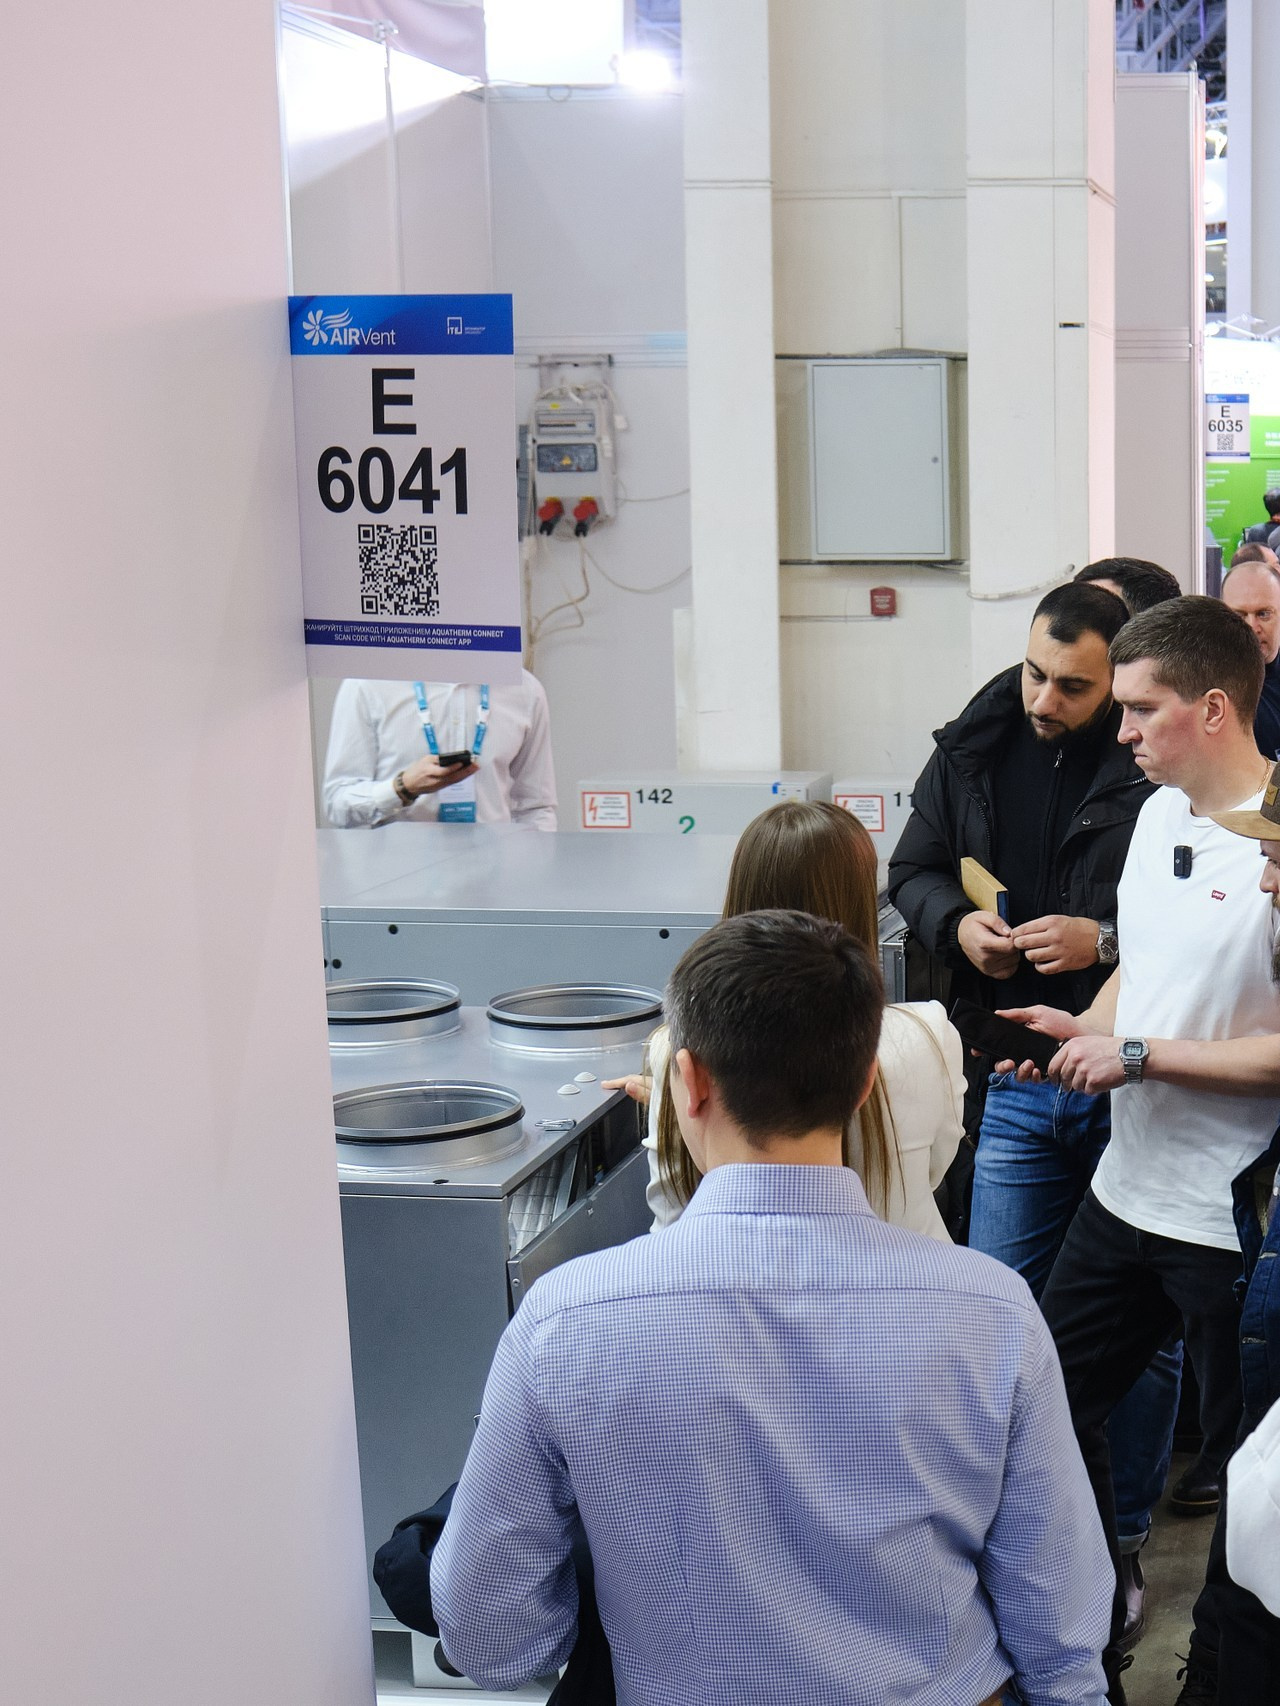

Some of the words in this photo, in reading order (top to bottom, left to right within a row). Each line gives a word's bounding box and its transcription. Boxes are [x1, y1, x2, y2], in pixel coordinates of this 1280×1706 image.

[329, 327, 396, 347] AIRVent
[371, 367, 417, 435] E
[1221, 405, 1231, 418] E
[1208, 420, 1243, 432] 6035
[317, 446, 469, 515] 6041
[344, 625, 380, 634] ШТРИХКОД
[380, 626, 431, 635] ПРИЛОЖЕНИЕМ
[431, 628, 472, 637] AQUATHERM
[472, 630, 504, 638] CONNECT
[352, 634, 369, 642] CODE
[386, 635, 426, 644] AQUATHERM
[426, 637, 457, 645] CONNECT
[458, 638, 472, 646] APP
[635, 788, 673, 804] 142
